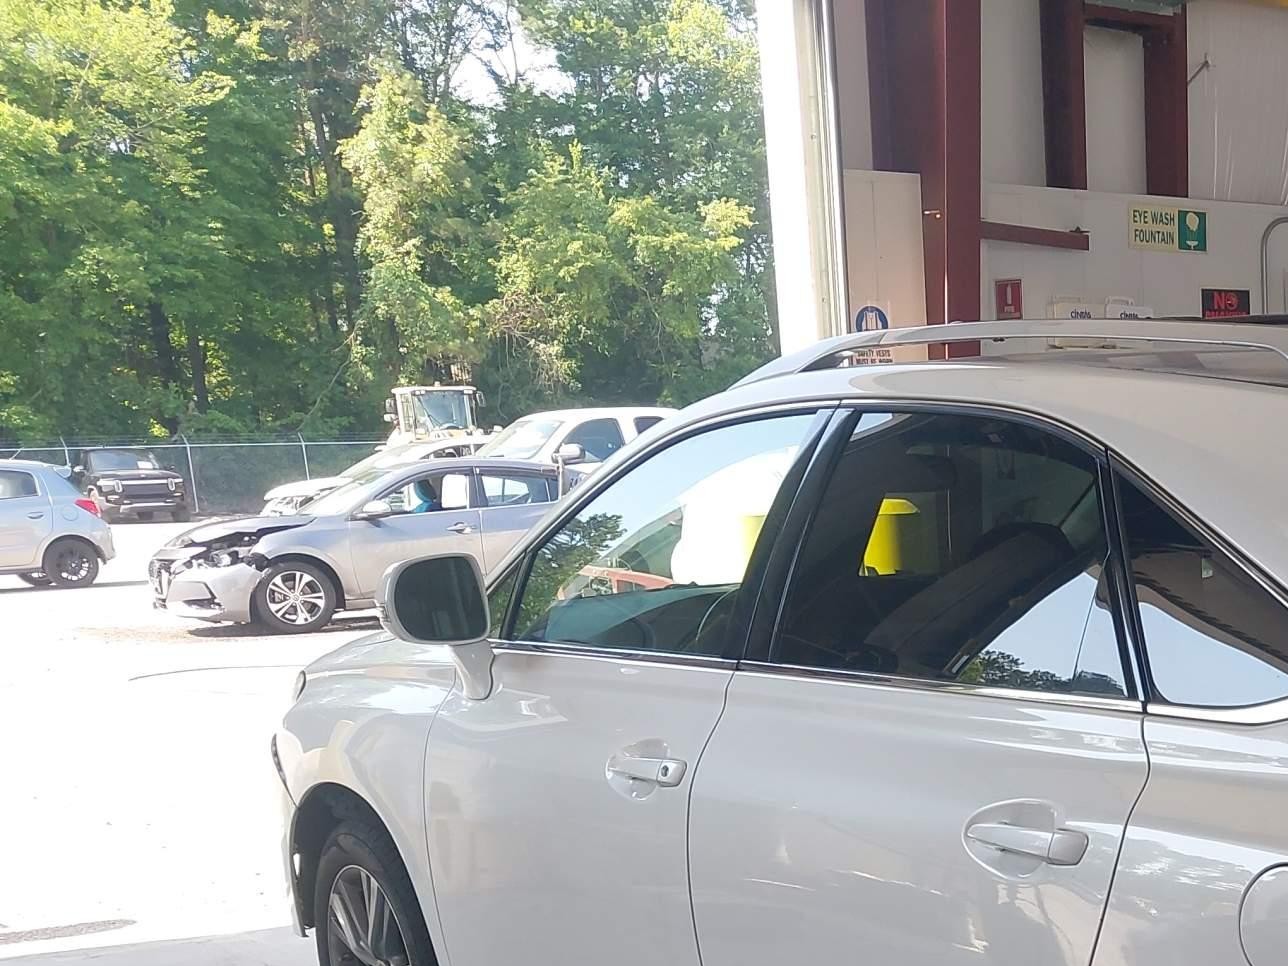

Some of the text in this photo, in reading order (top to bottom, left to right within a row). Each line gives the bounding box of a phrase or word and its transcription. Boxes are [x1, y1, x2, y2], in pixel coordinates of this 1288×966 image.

[1132, 209, 1175, 226] EYE WASH
[1133, 228, 1175, 246] FOUNTAIN
